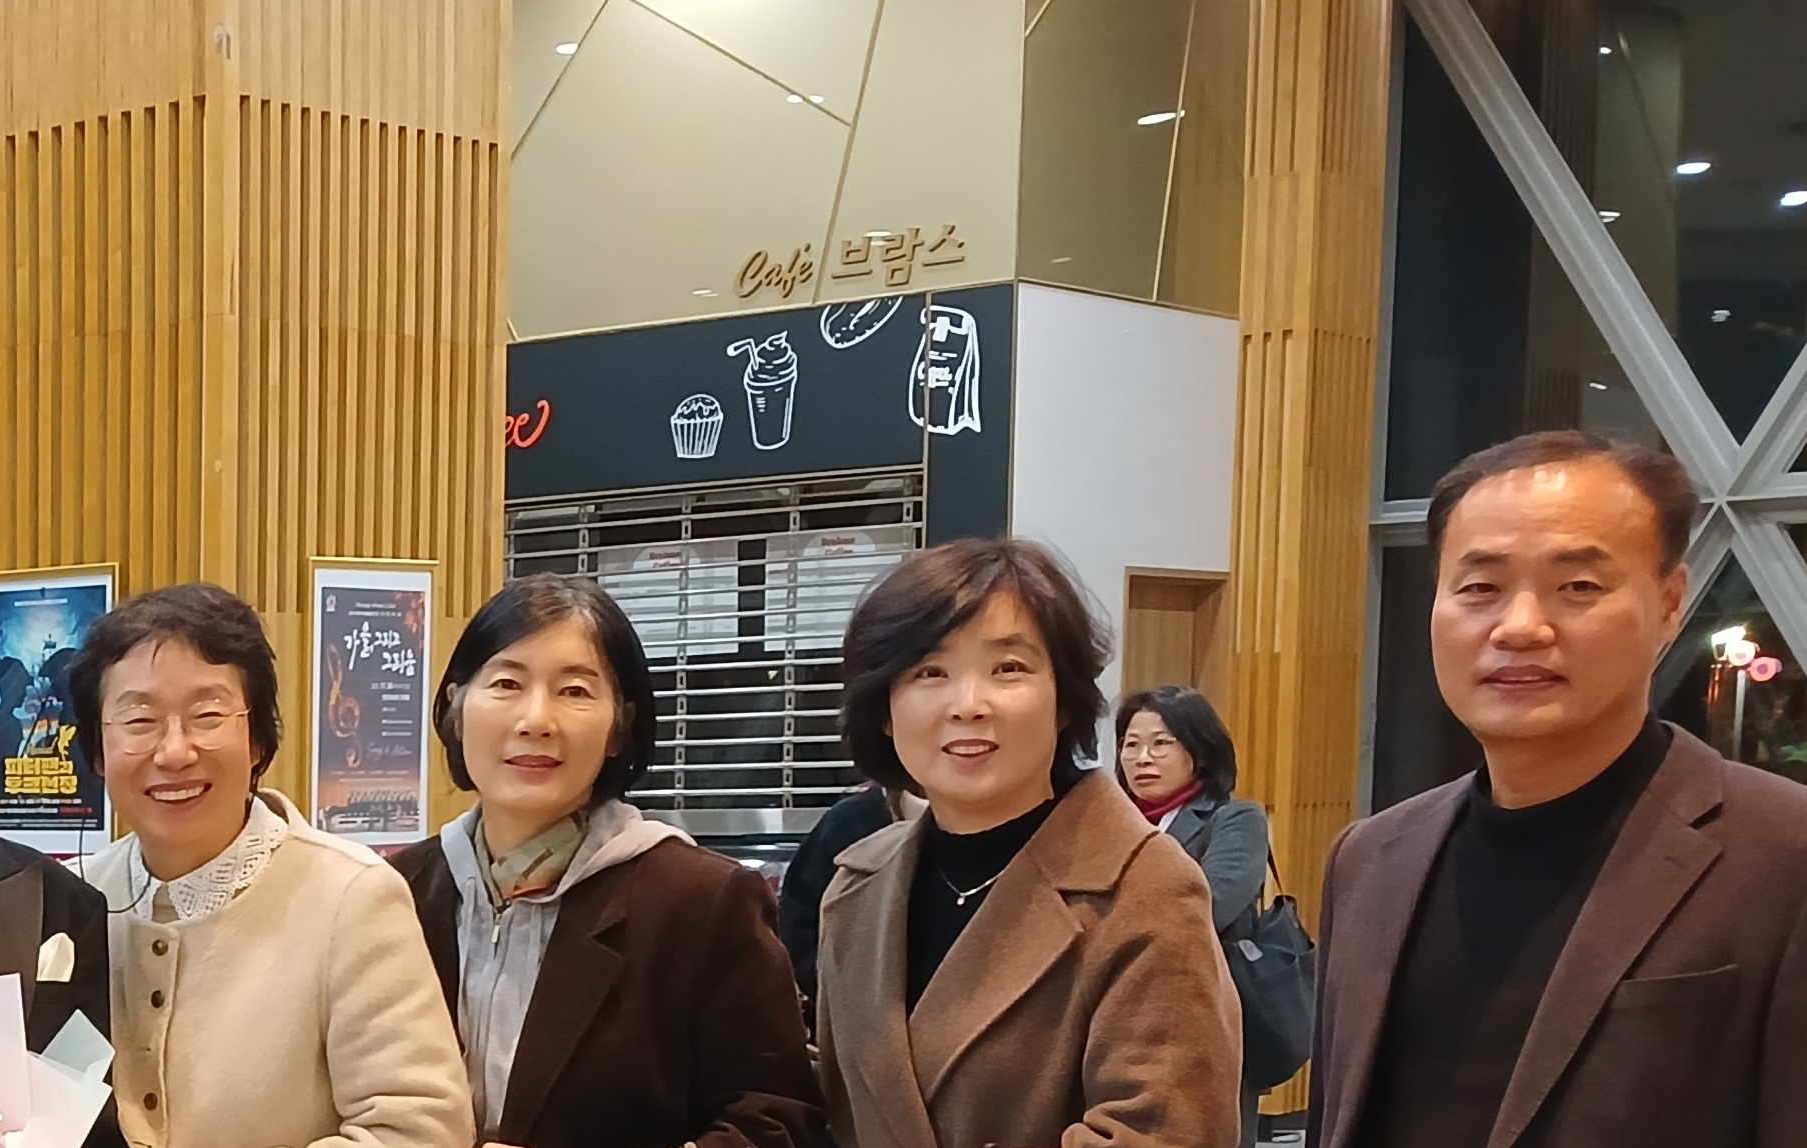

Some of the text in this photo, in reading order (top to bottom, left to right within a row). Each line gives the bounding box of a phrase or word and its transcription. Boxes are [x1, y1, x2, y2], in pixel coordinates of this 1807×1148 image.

[736, 224, 965, 299] Café 브람스
[380, 648, 417, 677] 그리움
[4, 757, 73, 776] 피터팬과
[4, 775, 78, 794] 후크선장
